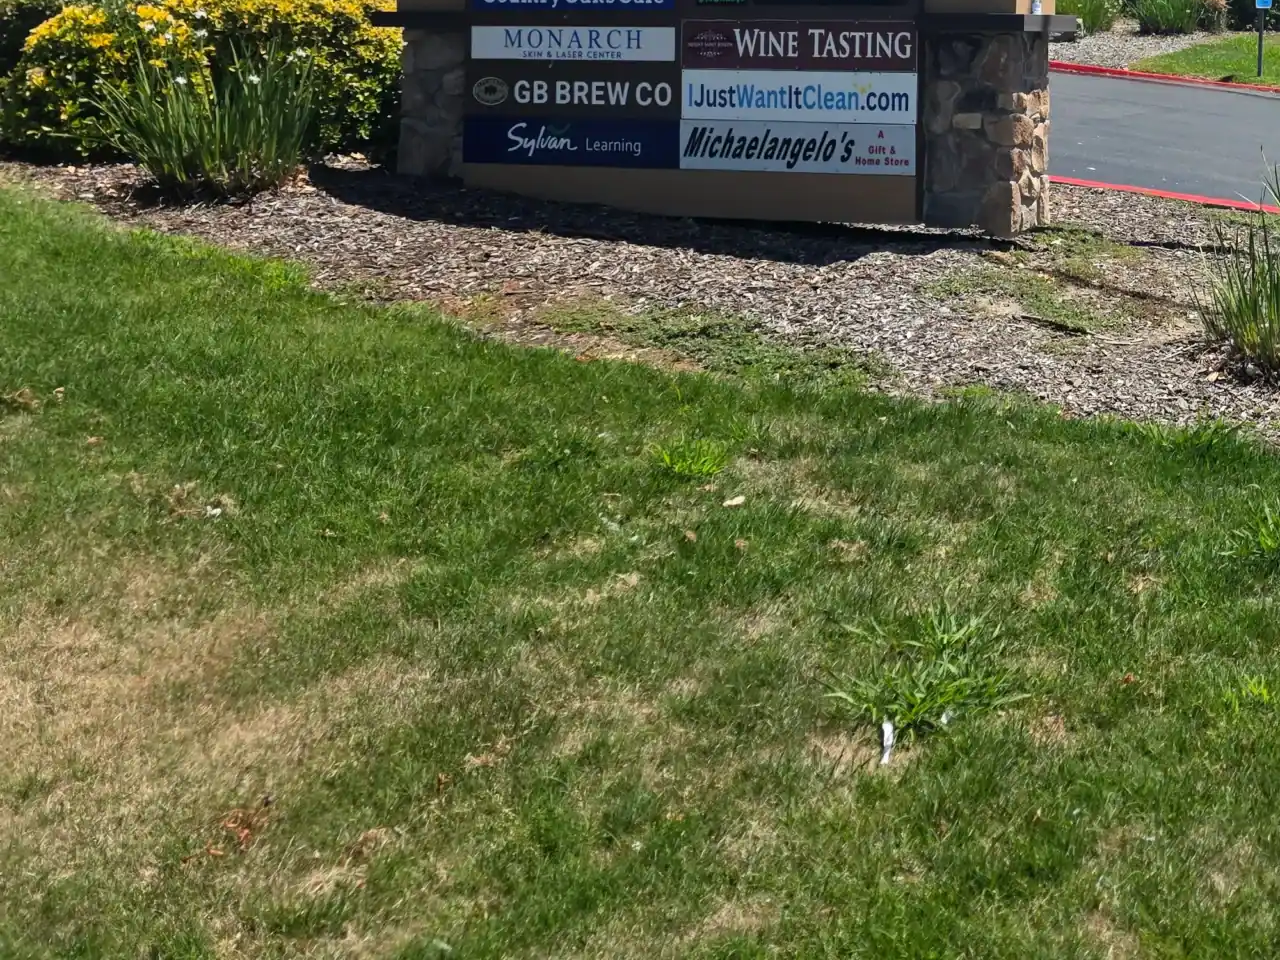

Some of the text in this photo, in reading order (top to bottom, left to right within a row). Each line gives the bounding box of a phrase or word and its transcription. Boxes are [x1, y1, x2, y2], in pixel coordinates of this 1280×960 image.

[503, 28, 643, 49] MONARCH
[733, 28, 913, 59] WINE TASTING
[522, 50, 622, 59] SKIN & LASER CENTER
[514, 80, 548, 104] GB
[555, 81, 630, 105] BREW
[635, 82, 671, 106] CO
[688, 82, 909, 112] IJustWantItClean.com
[507, 122, 641, 157] Sylvan Learning
[877, 130, 884, 139] A
[683, 126, 855, 170] Michaelangelo's
[868, 145, 896, 155] Gift &
[855, 156, 910, 166] Home Store
